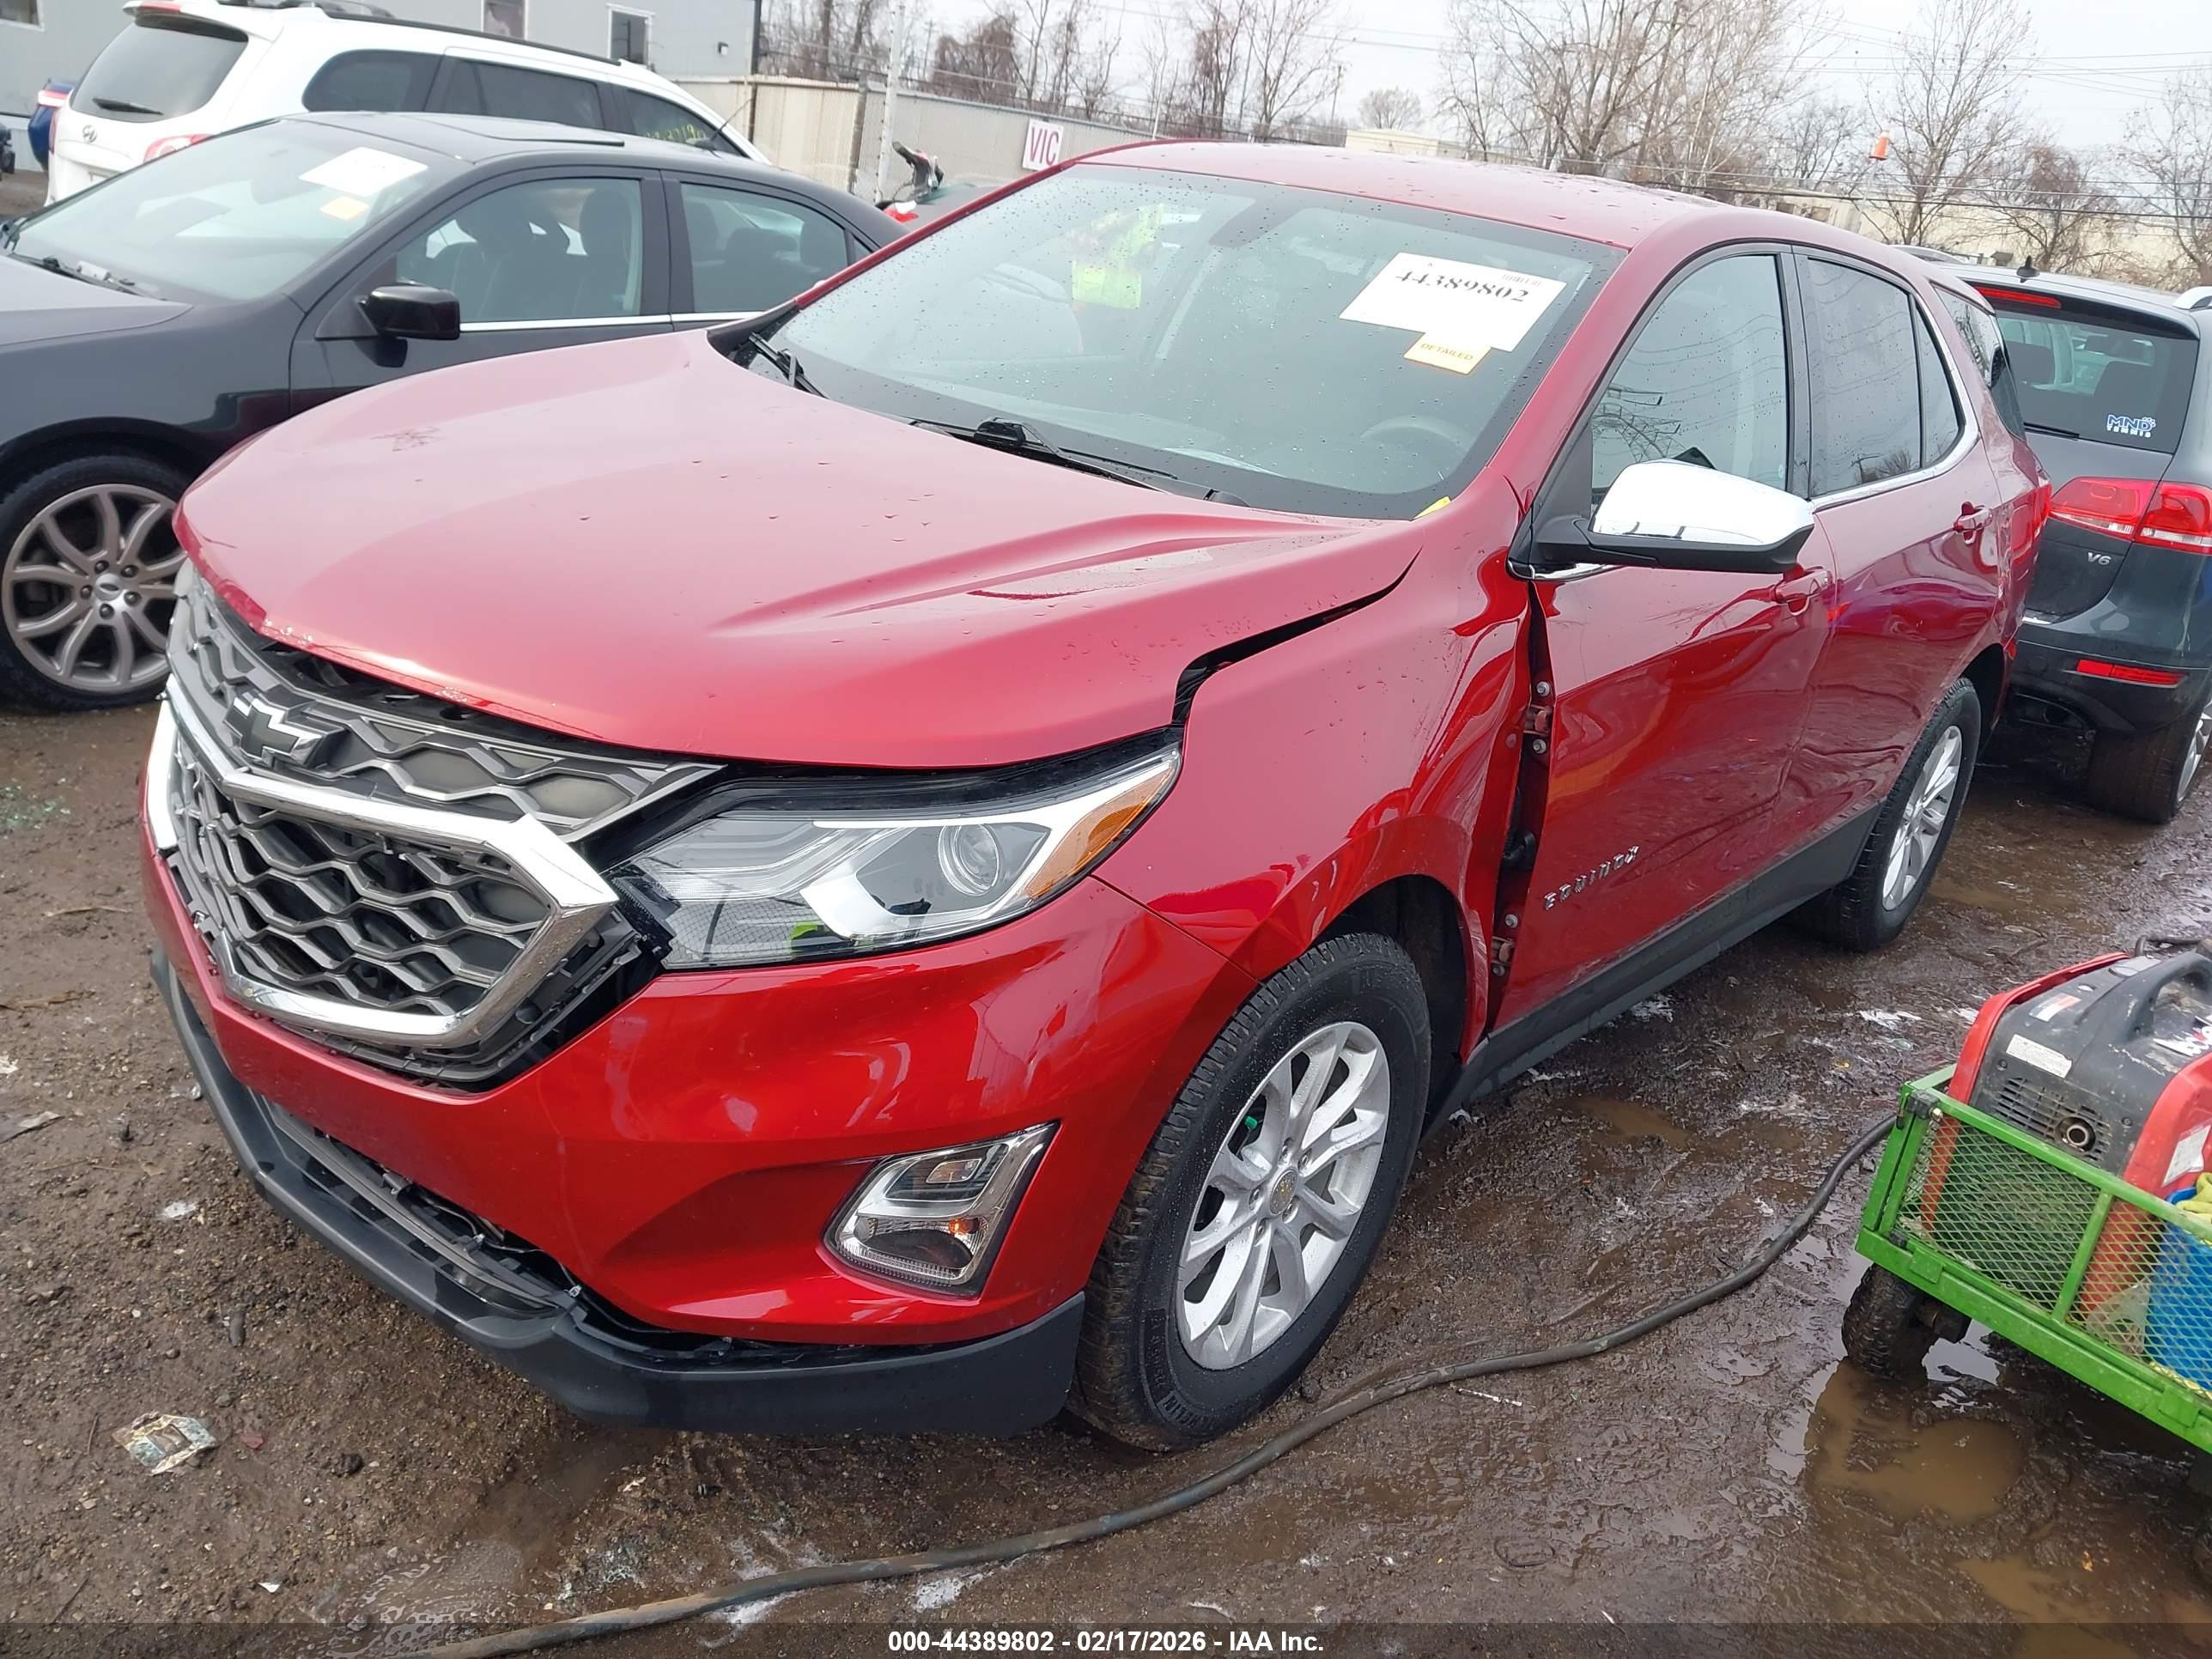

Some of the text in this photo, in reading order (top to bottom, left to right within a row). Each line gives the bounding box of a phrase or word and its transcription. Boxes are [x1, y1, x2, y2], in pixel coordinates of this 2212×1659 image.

[1030, 126, 1060, 166] VIC
[1395, 270, 1529, 302] 44389802
[1419, 343, 1474, 362] DETAILED
[2106, 414, 2154, 432] MND
[2087, 551, 2112, 565] V6
[1545, 846, 1639, 911] EQUINOX
